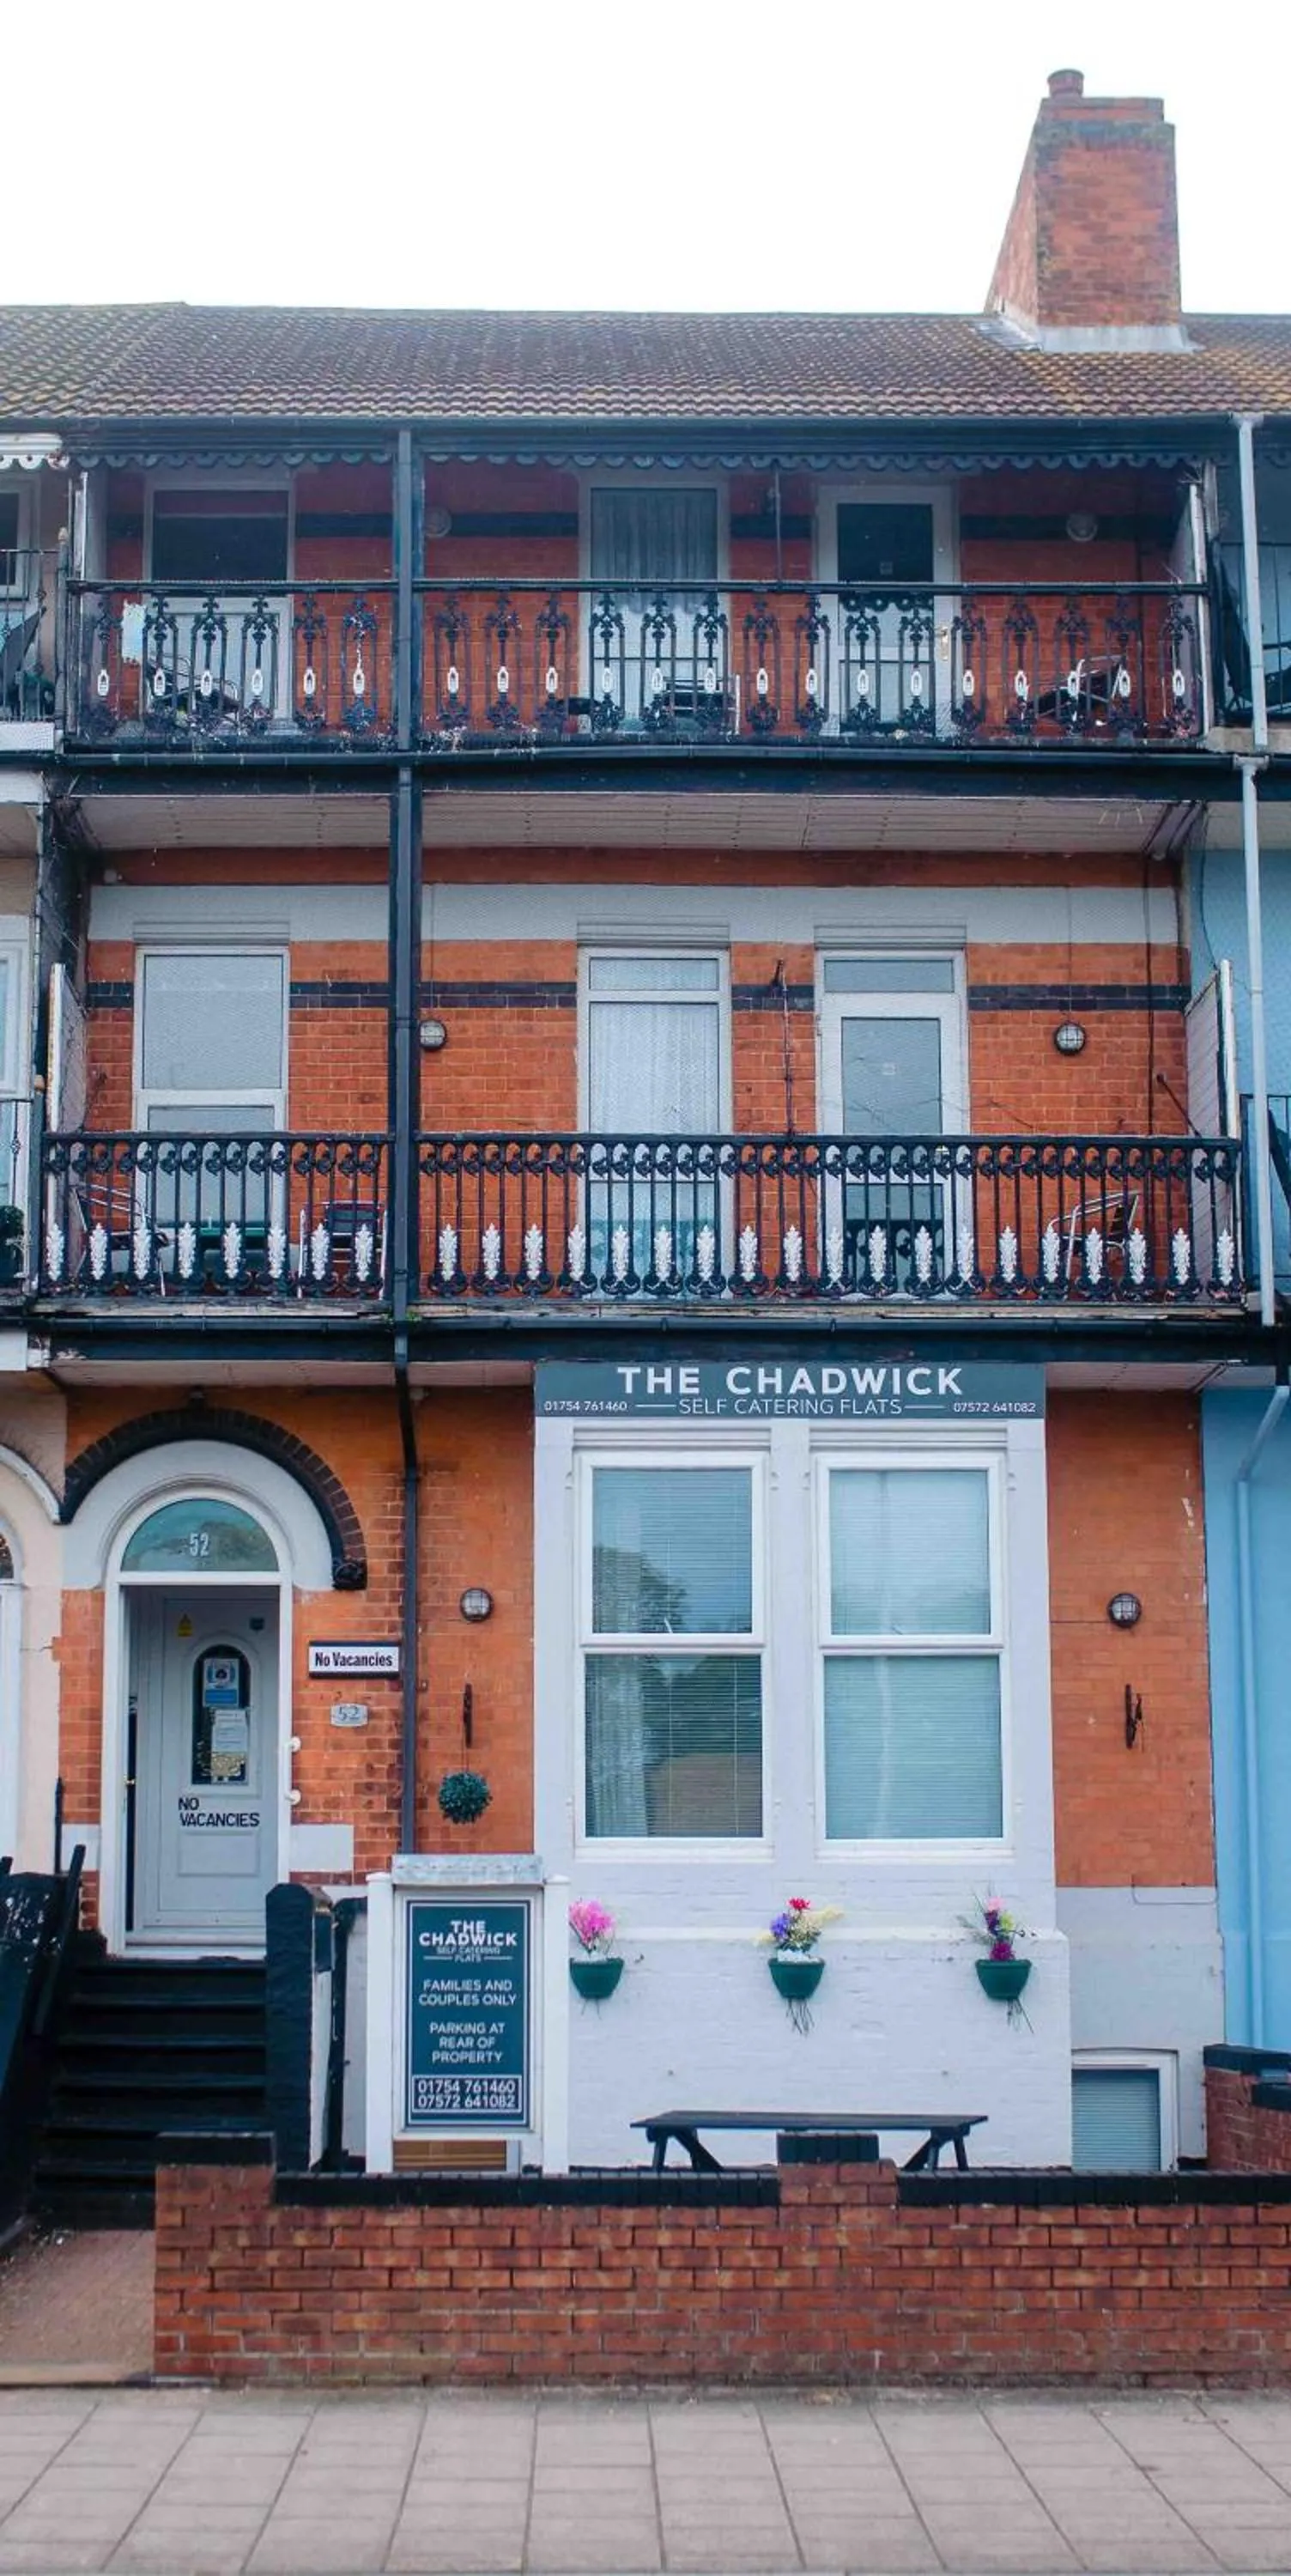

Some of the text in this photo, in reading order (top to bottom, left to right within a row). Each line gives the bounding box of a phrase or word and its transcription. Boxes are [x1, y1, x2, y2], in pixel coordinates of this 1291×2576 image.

[617, 1366, 963, 1395] THE CHADWICK
[544, 1400, 627, 1413] 01754 761460
[679, 1398, 902, 1415] SELF CATERING FLATS
[953, 1401, 1036, 1413] 07572 641082
[188, 1532, 210, 1557] 52
[314, 1650, 393, 1668] No Vacancies
[338, 1705, 360, 1721] 52
[178, 1798, 200, 1811] NO
[179, 1813, 260, 1827] VACANCIES
[451, 1920, 487, 1933] THE
[419, 1933, 518, 1947] CHADWICK
[454, 1954, 482, 1963] FLATS
[423, 1979, 512, 1992] FAMILIES AND
[418, 1993, 517, 2006] COUPLES ONLY
[429, 2022, 506, 2035] PARKING AT
[439, 2037, 496, 2049] REAR OF
[432, 2050, 504, 2064] PROPERTY
[418, 2080, 515, 2093] 01754 761460
[418, 2094, 515, 2109] 07572 641082
